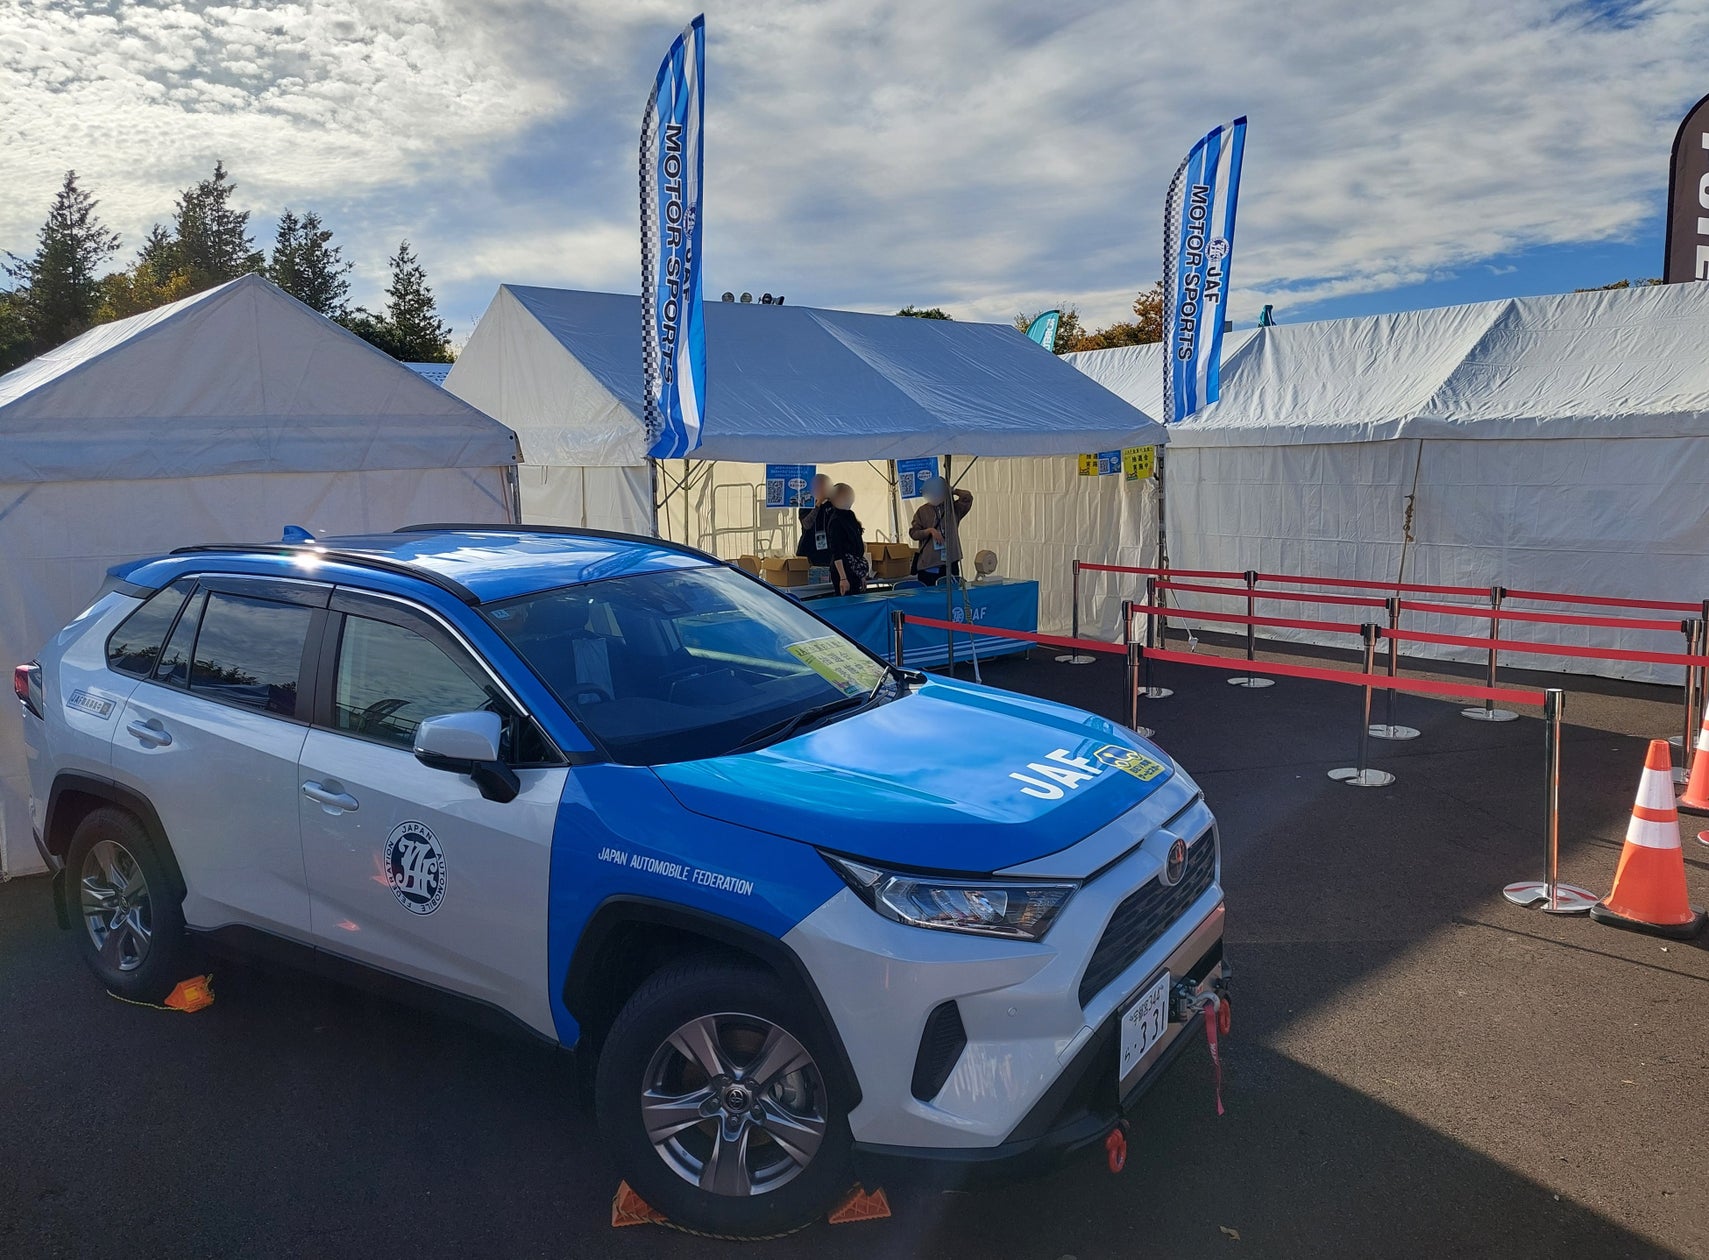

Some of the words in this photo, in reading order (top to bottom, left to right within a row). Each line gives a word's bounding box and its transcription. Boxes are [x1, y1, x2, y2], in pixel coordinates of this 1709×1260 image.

[662, 124, 682, 247] MOTOR
[1186, 184, 1209, 266] MOTOR
[1204, 266, 1222, 304] JAF
[662, 259, 680, 385] SPORTS
[1178, 275, 1200, 361] SPORTS
[1008, 748, 1103, 800] JAF
[402, 824, 432, 841] JAPAN
[421, 853, 445, 912] AUTOMOBILE
[598, 847, 628, 866] JAPAN
[630, 854, 691, 881] AUTOMOBILE
[692, 869, 754, 896] FEDERATION
